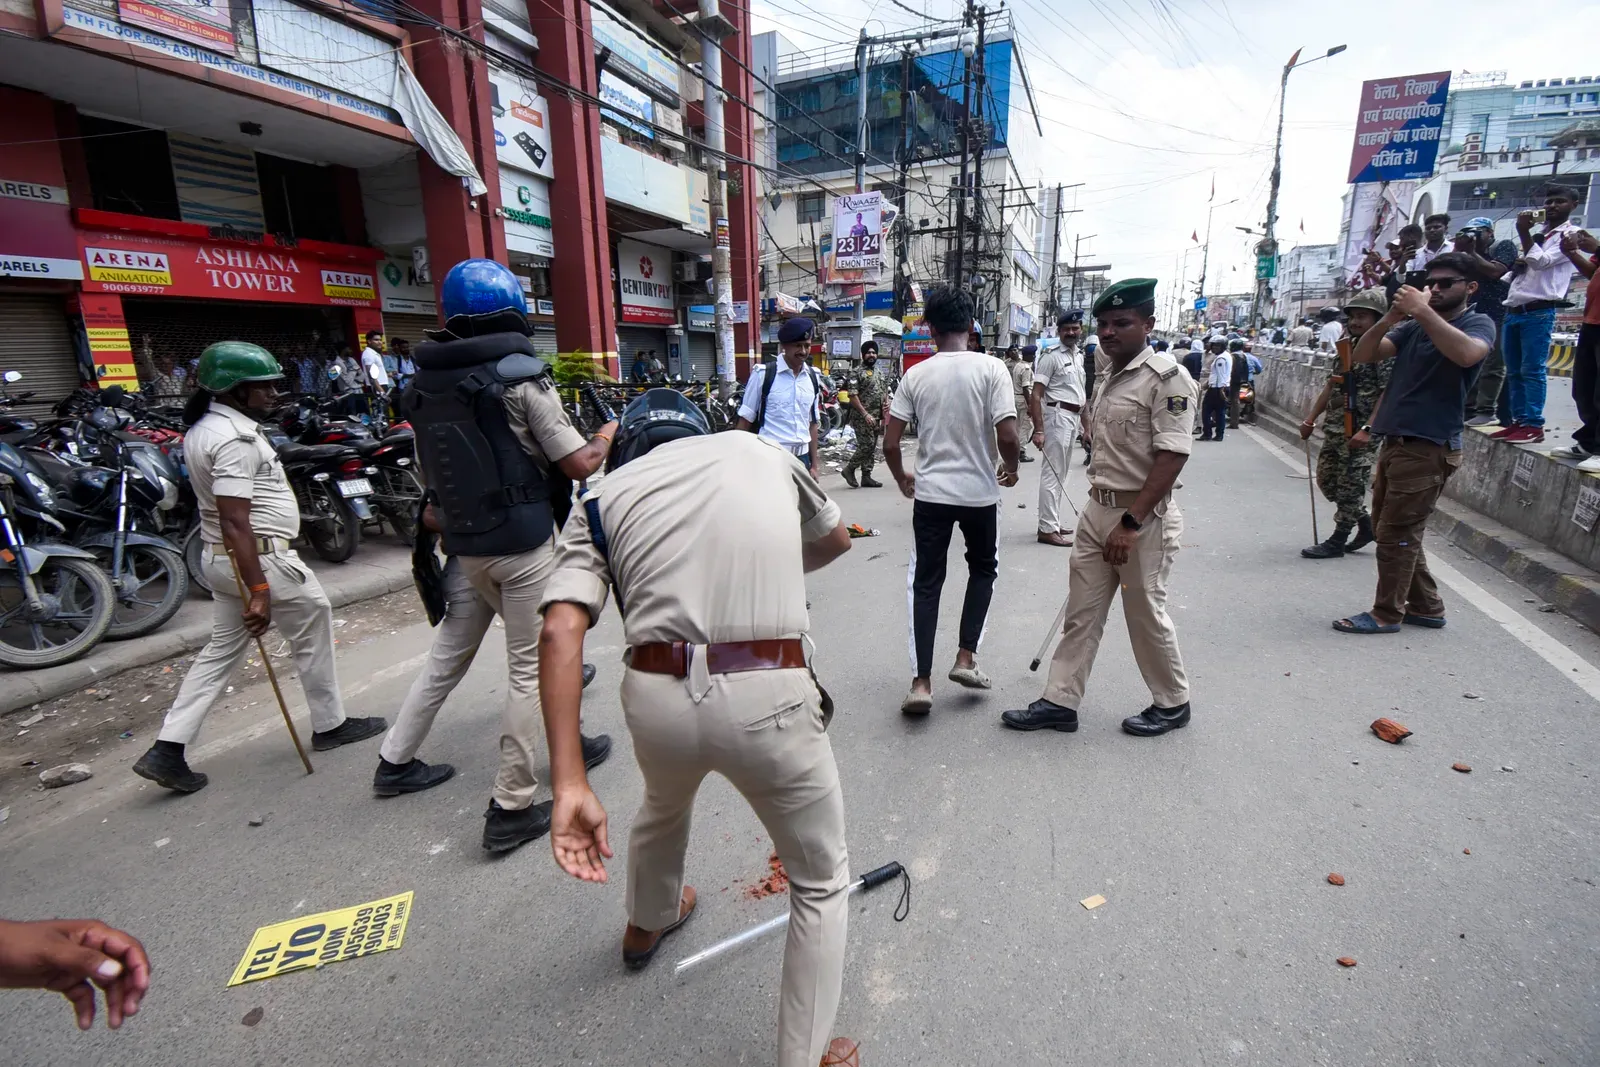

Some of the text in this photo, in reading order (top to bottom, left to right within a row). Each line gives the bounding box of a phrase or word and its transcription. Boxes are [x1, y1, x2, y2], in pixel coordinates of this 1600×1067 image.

[75, 13, 94, 27] TH
[173, 43, 225, 67] ASHINA
[224, 60, 266, 81] TOWER
[268, 73, 331, 101] EXHIBITION
[1374, 79, 1439, 100] ठेला, रिक्शा
[1363, 102, 1443, 124] एवं व्यवसायिक
[1358, 124, 1440, 146] वाहनों का प्रवेश
[1371, 149, 1405, 168] वर्जित
[839, 196, 879, 211] RIWAAZZ
[838, 234, 879, 253] 23 24
[93, 252, 166, 269] ARENA
[195, 246, 300, 273] ASHIANA
[838, 258, 879, 268] LEMON TREE
[99, 271, 168, 284] ANIMATION
[206, 269, 295, 293] TOWER
[325, 273, 372, 287] ARENA
[102, 283, 164, 294] 9006939777
[329, 289, 373, 299] ANIMATION
[622, 278, 670, 299] CENTURYPLY
[276, 923, 326, 972] YO
[318, 926, 348, 961] OOM
[242, 942, 281, 980] TEL
